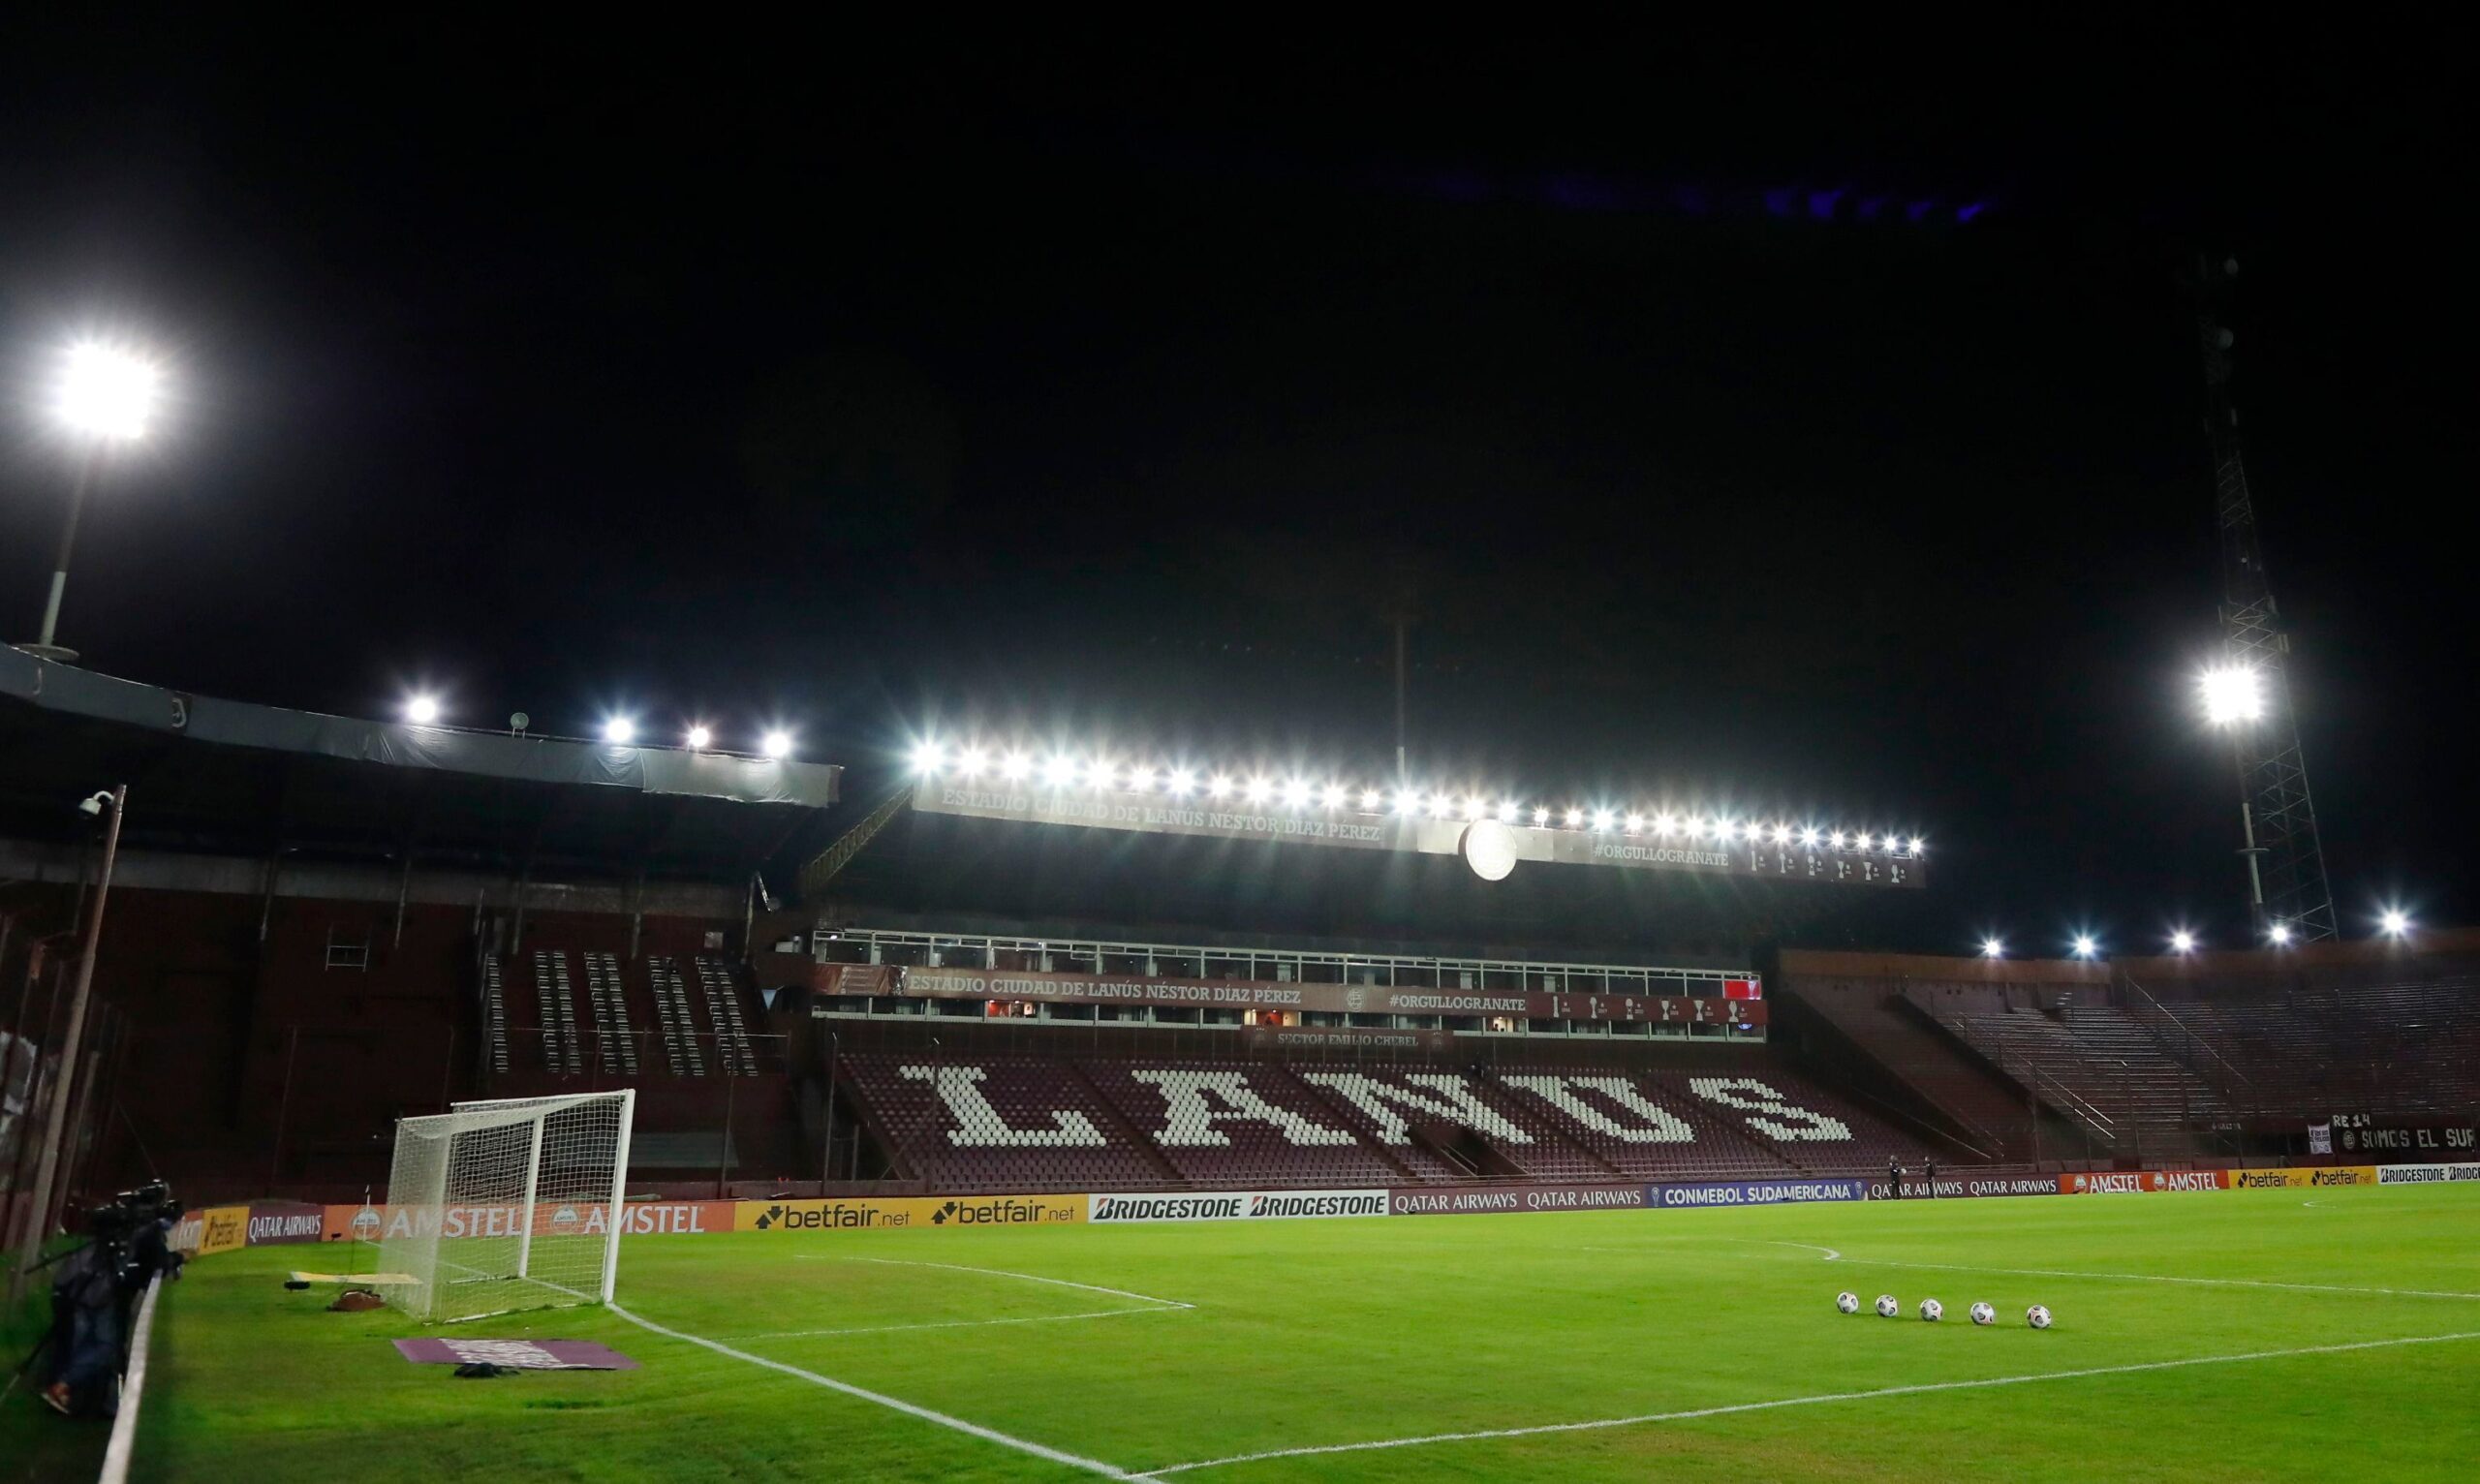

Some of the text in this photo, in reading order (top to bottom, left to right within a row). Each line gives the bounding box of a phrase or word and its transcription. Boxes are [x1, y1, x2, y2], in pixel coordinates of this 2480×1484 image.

[1112, 805, 1138, 822] DE
[1328, 819, 1380, 841] PÉREZ
[1594, 844, 1728, 867] #ORGULLOGRANATE
[910, 975, 985, 993] ESTADIO
[990, 978, 1057, 996] CIUDAD
[1061, 981, 1084, 997] DE
[1088, 980, 1141, 999] LANÚS
[1145, 981, 1211, 1001] NÉSTOR
[1254, 986, 1301, 1005] PÉREZ
[1389, 994, 1526, 1013] #ORGULLOGRANATE
[1278, 1034, 1325, 1045] SECTOR
[2417, 1128, 2438, 1148] EL
[2090, 1174, 2144, 1193] AMSTEL
[2168, 1172, 2219, 1191] AMSTEL
[2381, 1167, 2445, 1183] BRIDGESTONE
[1665, 1184, 1851, 1205] CONMEBOL SUDAMERICANA
[1872, 1183, 1911, 1199] QAAR
[1969, 1179, 2057, 1196] QATAR AIRWAYS
[1094, 1197, 1243, 1220] BRIDGESTONE
[1250, 1194, 1385, 1217] BRIDGESTONE
[1395, 1192, 1517, 1214] QATAR AIRWAYS
[1527, 1190, 1641, 1209] QATAR AIRWAYS
[249, 1215, 322, 1243] QATAR AIRWAYS
